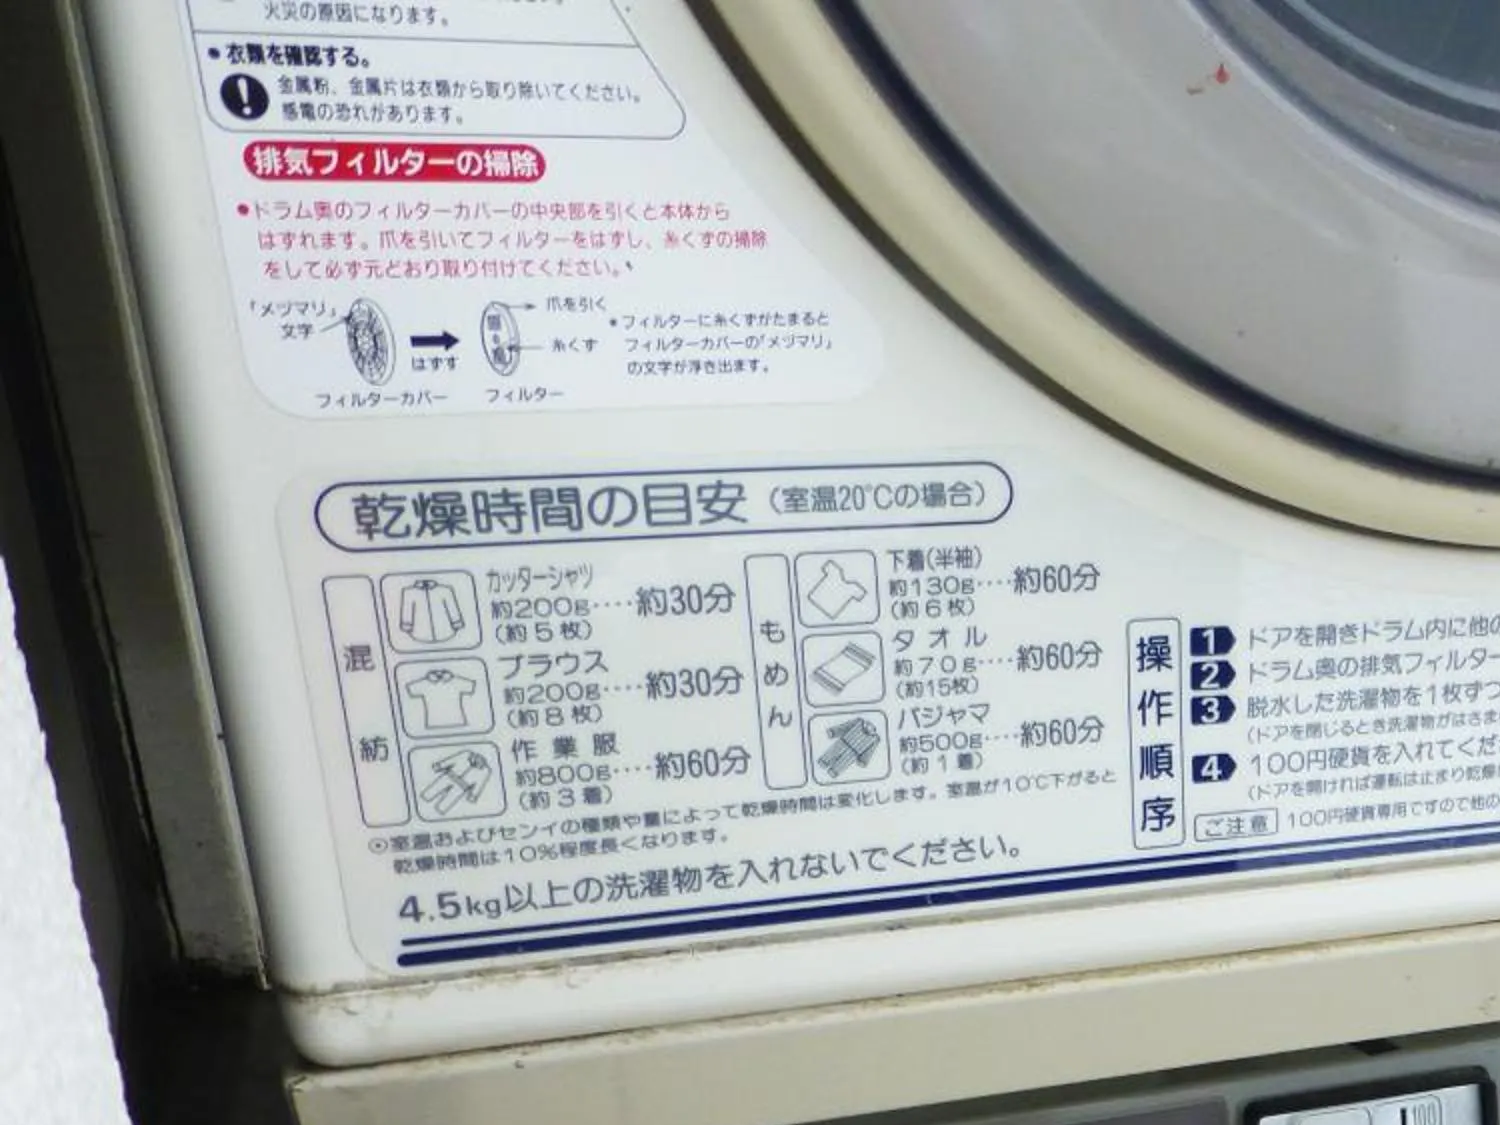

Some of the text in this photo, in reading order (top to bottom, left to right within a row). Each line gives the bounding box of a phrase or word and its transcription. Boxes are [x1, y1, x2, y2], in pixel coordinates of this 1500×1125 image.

[252, 144, 539, 177] 排気フィルターの掃除
[315, 390, 449, 409] フィルターカバー
[485, 386, 564, 404] フィルター
[351, 479, 749, 541] 乾燥時間の目安
[486, 563, 594, 593] カッターシャツ
[891, 626, 988, 653] タオル
[500, 650, 609, 681] ブラウス
[1135, 634, 1177, 833] 操作順序
[399, 834, 1021, 924] 4.5kg以上の洗濯物を入れないでください。
